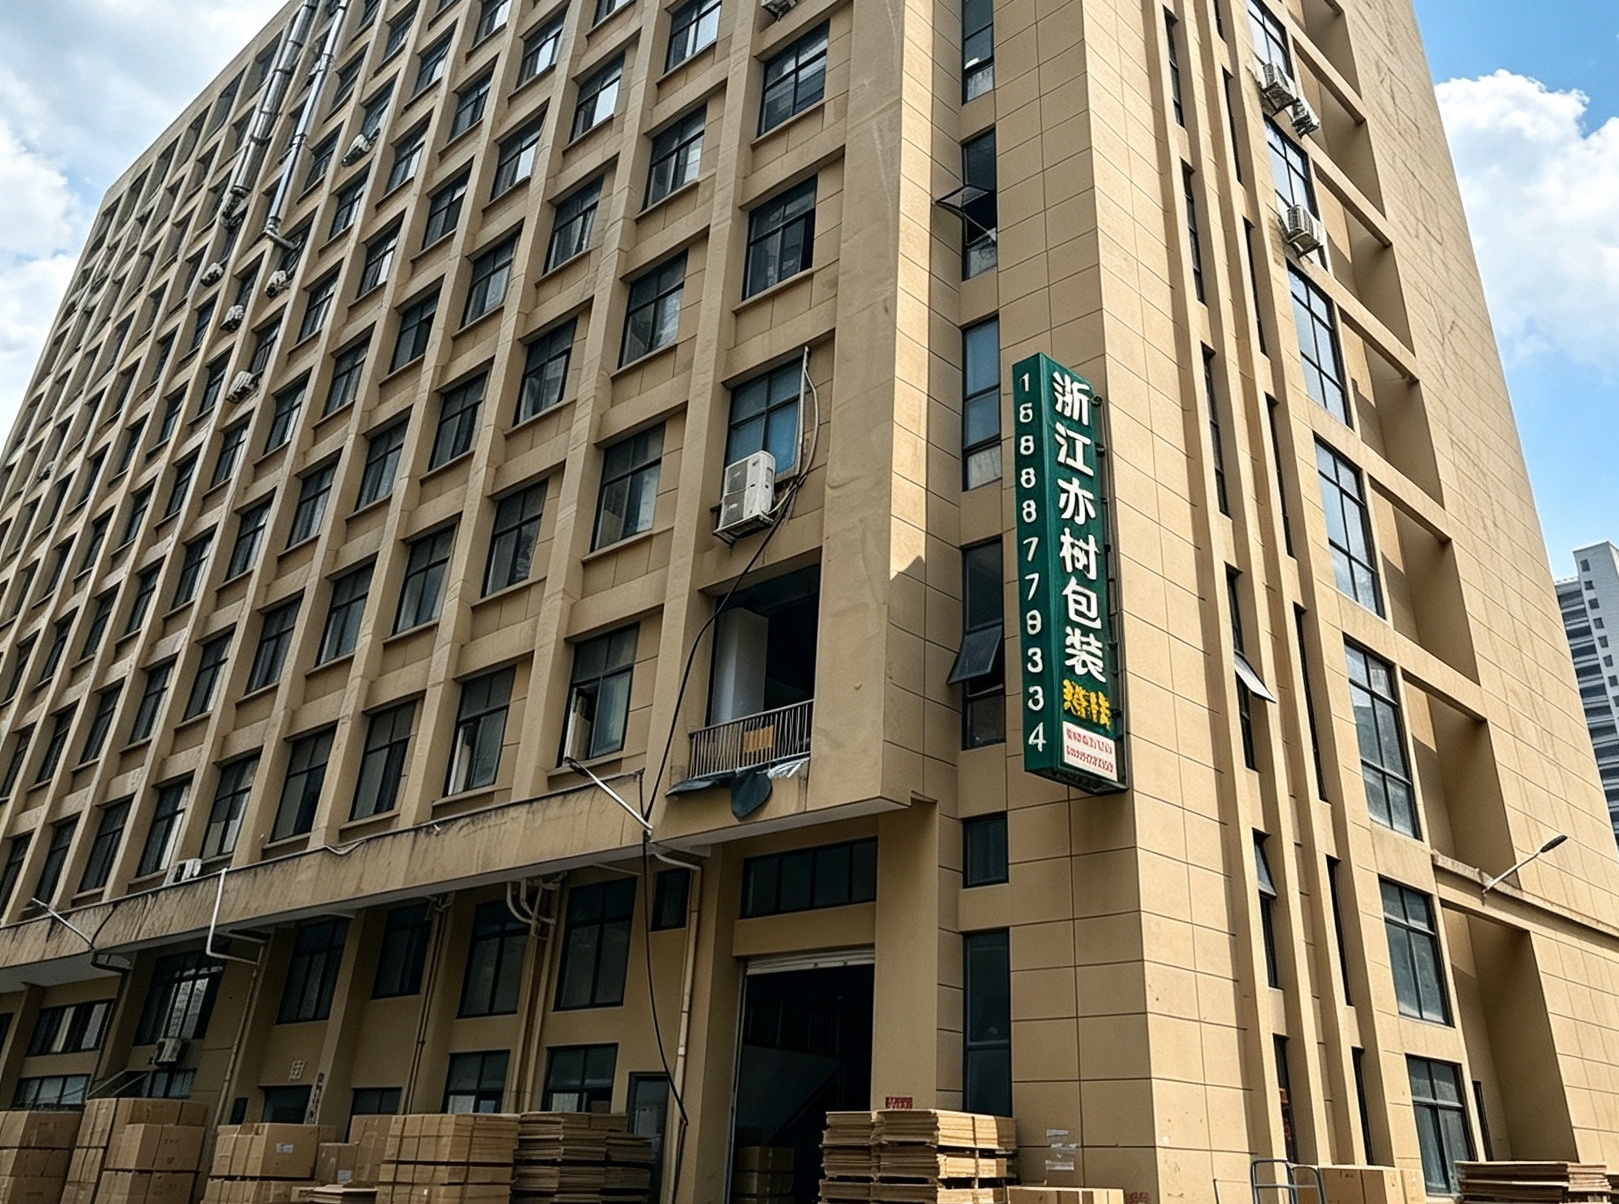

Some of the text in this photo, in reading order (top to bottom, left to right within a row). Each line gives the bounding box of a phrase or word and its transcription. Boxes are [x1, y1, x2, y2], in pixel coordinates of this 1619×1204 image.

[1052, 372, 1107, 683] 浙江亦树包装
